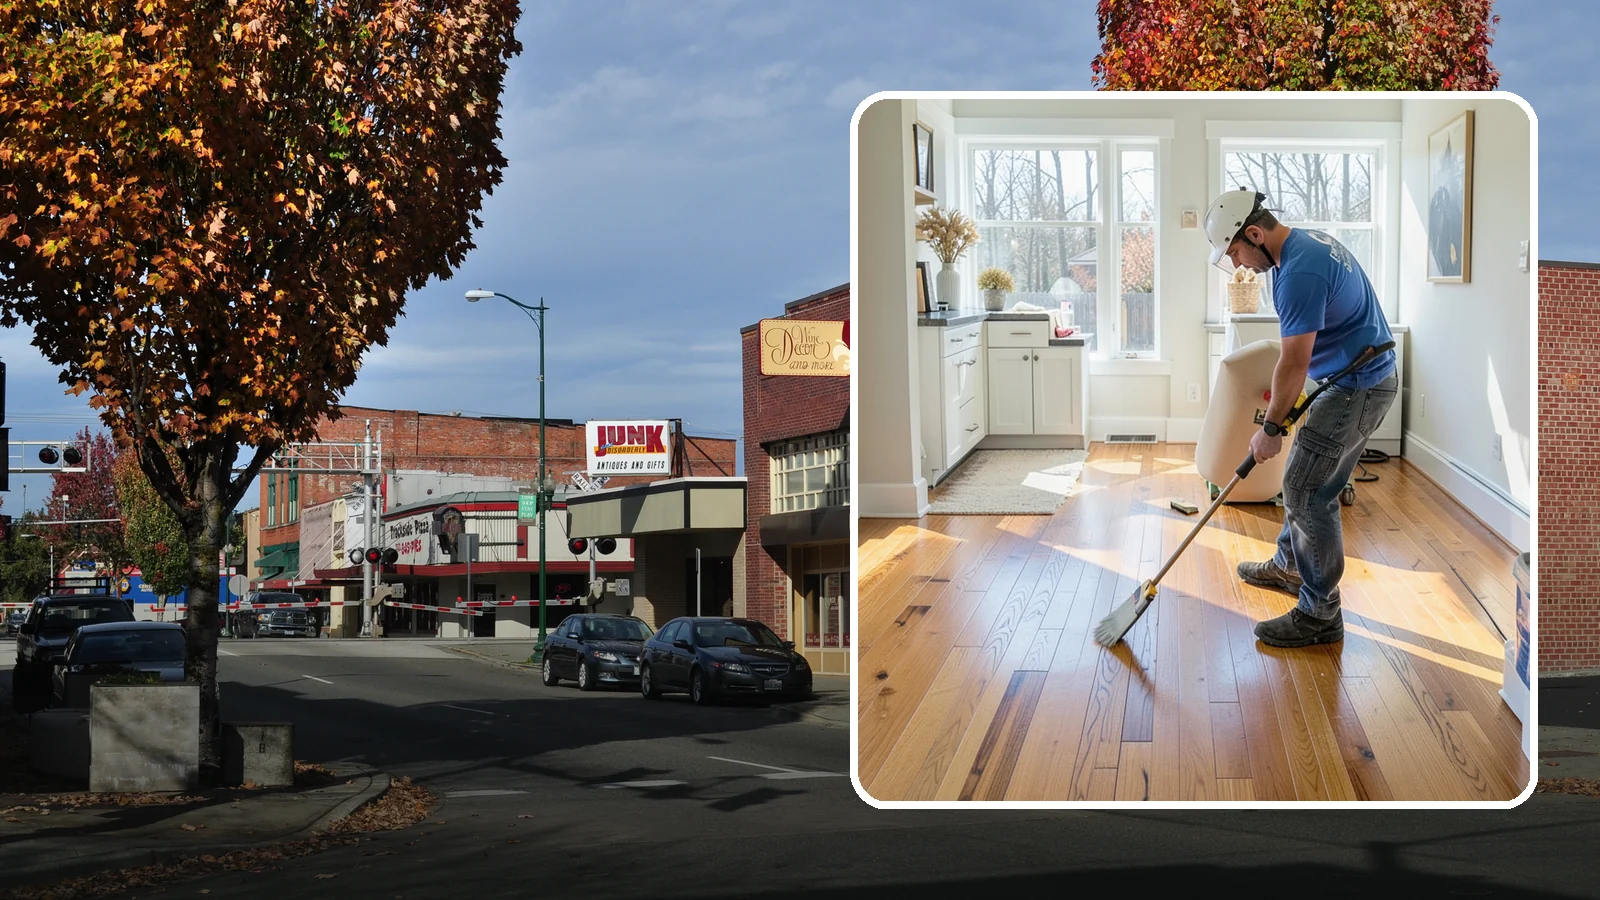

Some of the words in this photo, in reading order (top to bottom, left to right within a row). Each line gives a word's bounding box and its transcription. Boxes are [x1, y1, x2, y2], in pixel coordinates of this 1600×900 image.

[764, 327, 831, 366] Decor
[595, 425, 665, 457] JUNK
[607, 446, 645, 454] DISORDERLY
[597, 461, 628, 470] ANTIQUES
[630, 461, 644, 470] AND
[646, 460, 666, 469] GIFTS
[414, 519, 429, 535] Pizza
